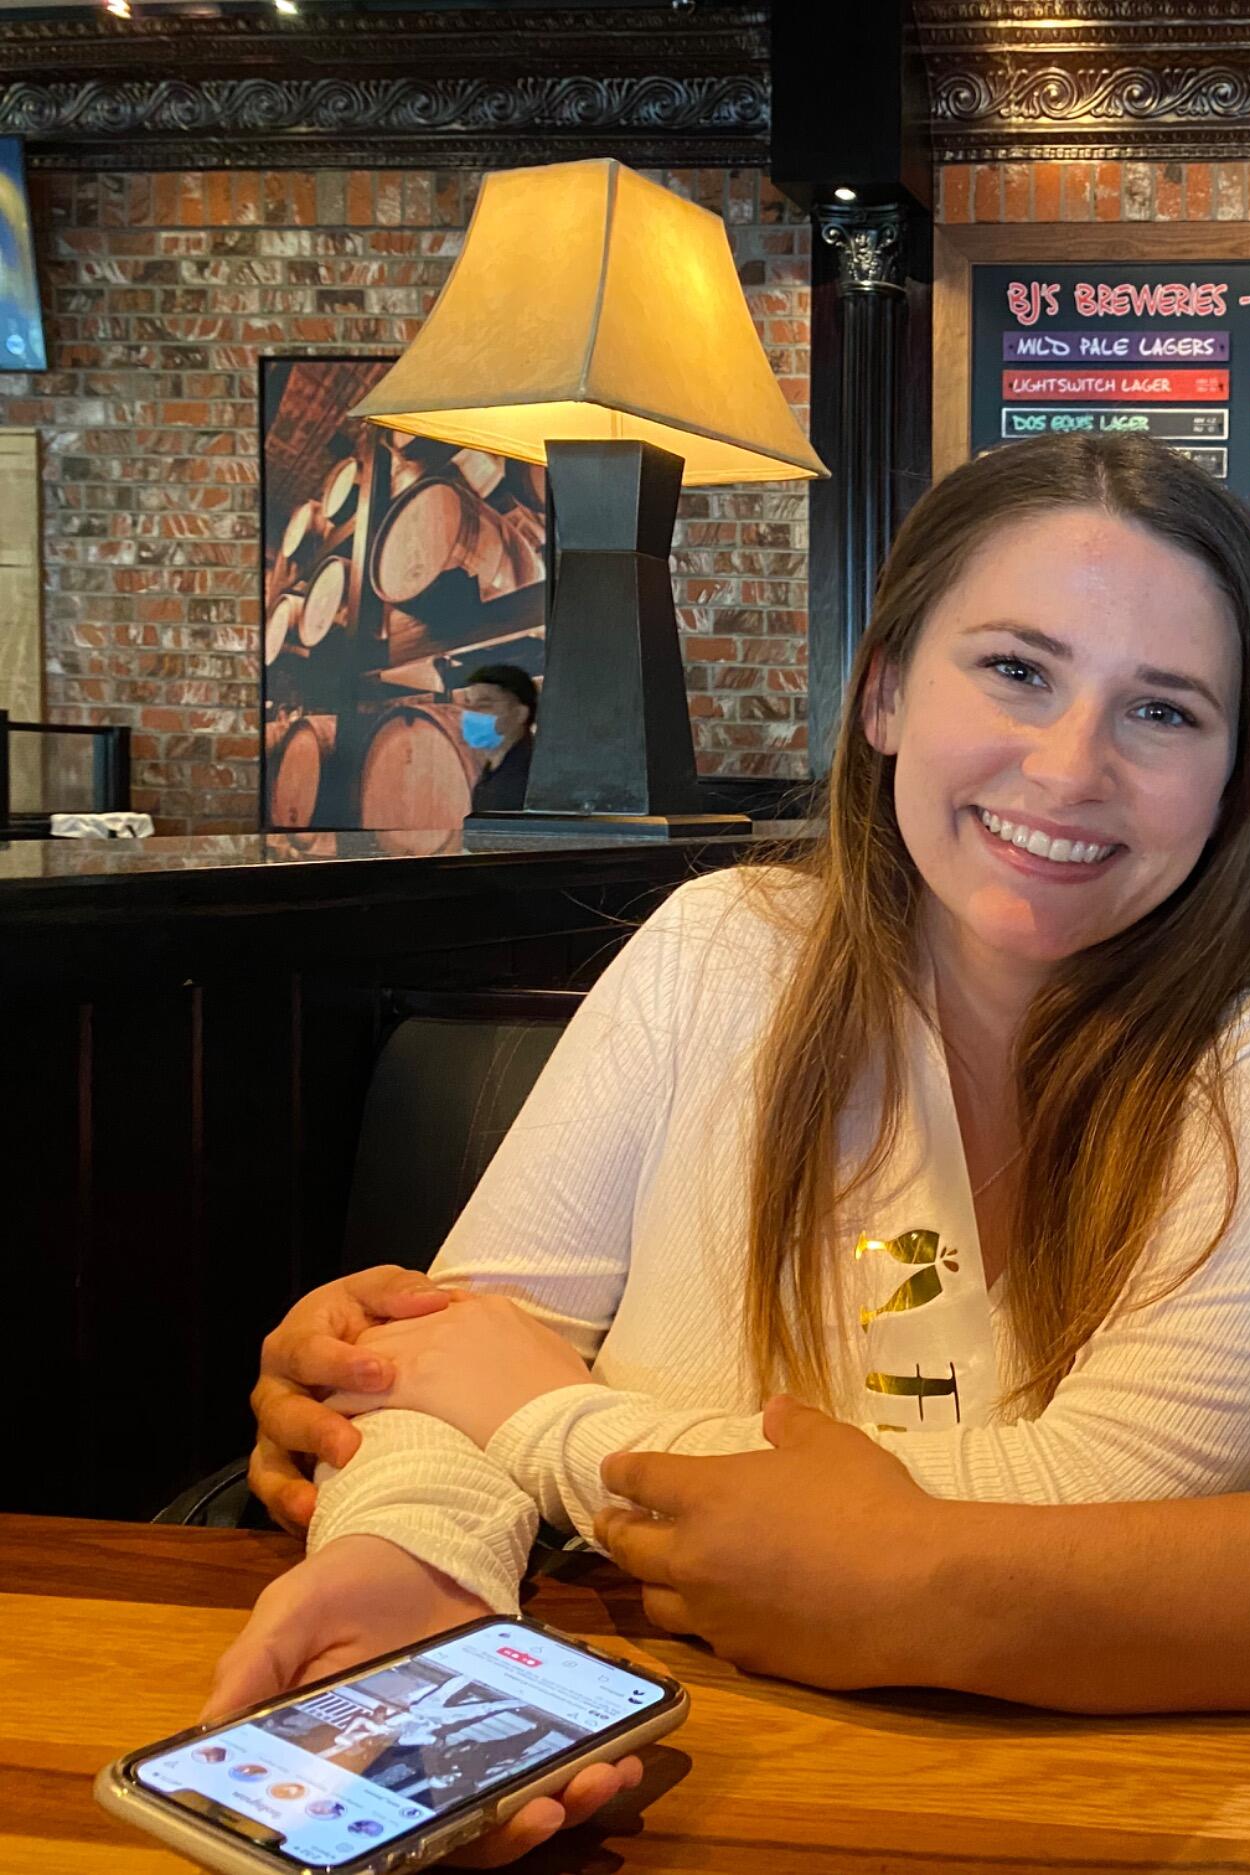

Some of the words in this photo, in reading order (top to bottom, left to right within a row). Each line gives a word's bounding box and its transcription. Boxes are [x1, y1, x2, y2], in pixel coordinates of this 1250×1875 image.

[1007, 281, 1061, 325] BJ'S
[1075, 282, 1228, 317] BREWERIES
[1016, 336, 1070, 356] MILD
[1080, 338, 1130, 355] PALE
[1139, 338, 1215, 355] LAGERS
[1012, 378, 1116, 393] LIGHTSWITCH
[1121, 378, 1172, 393] LAGER
[1012, 415, 1047, 431] DOS
[1100, 415, 1150, 431] LAGER
